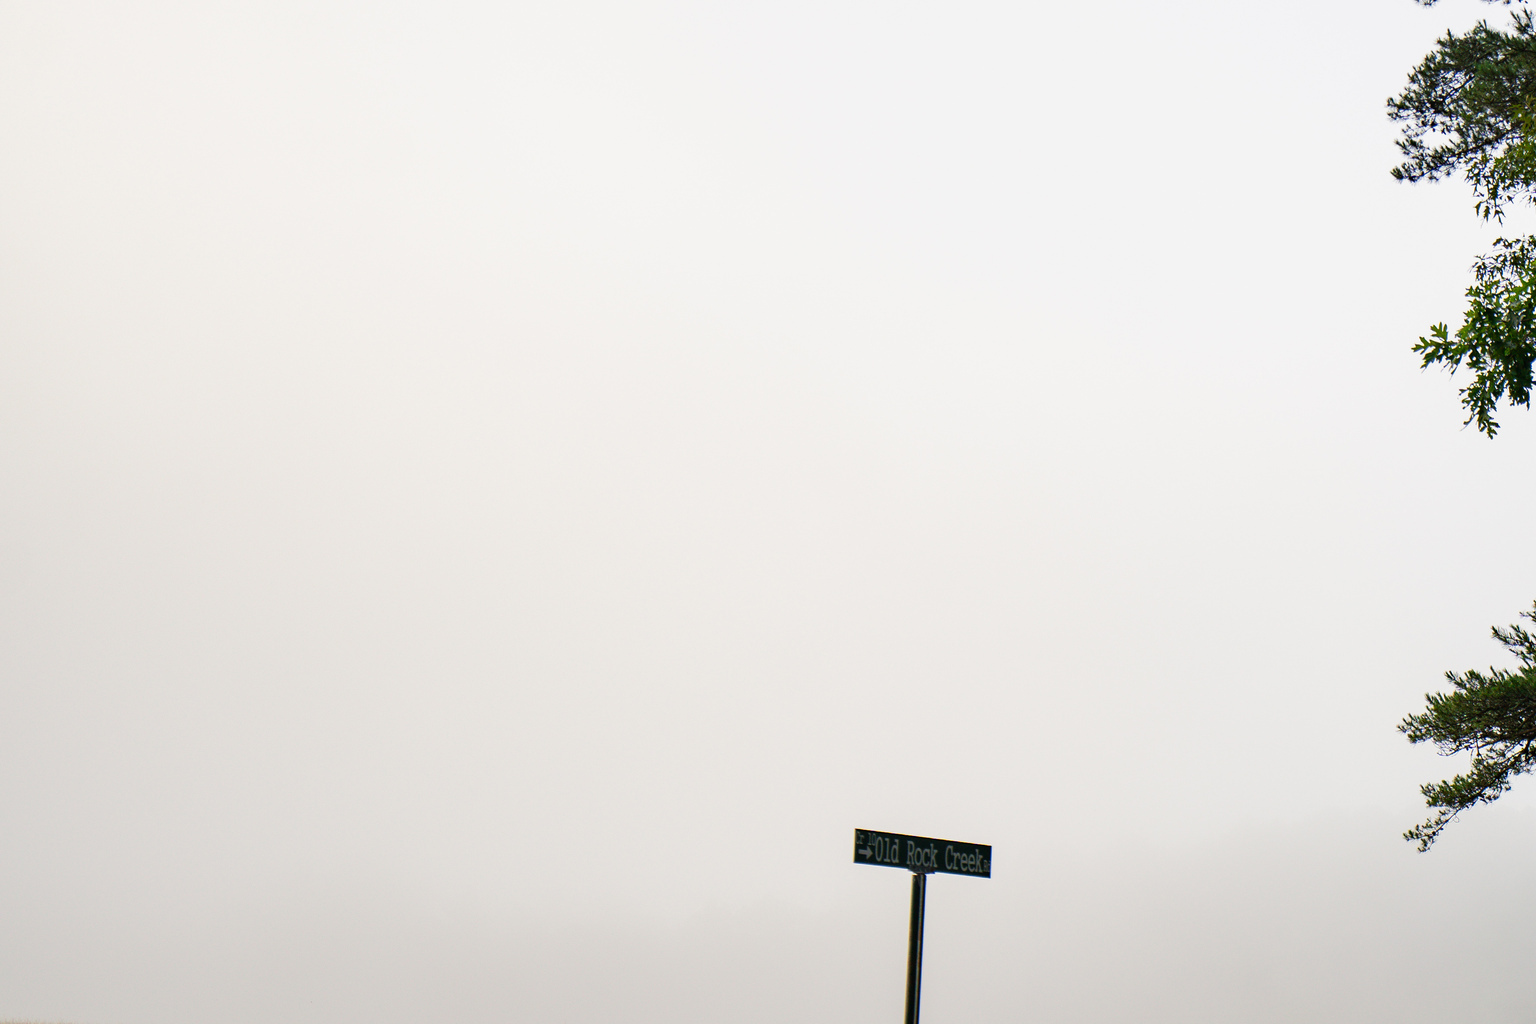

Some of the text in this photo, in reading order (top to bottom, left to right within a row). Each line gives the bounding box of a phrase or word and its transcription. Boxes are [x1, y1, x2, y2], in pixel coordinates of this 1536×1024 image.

[875, 836, 900, 864] Old
[906, 840, 938, 868] Rock
[945, 843, 984, 873] Creek
